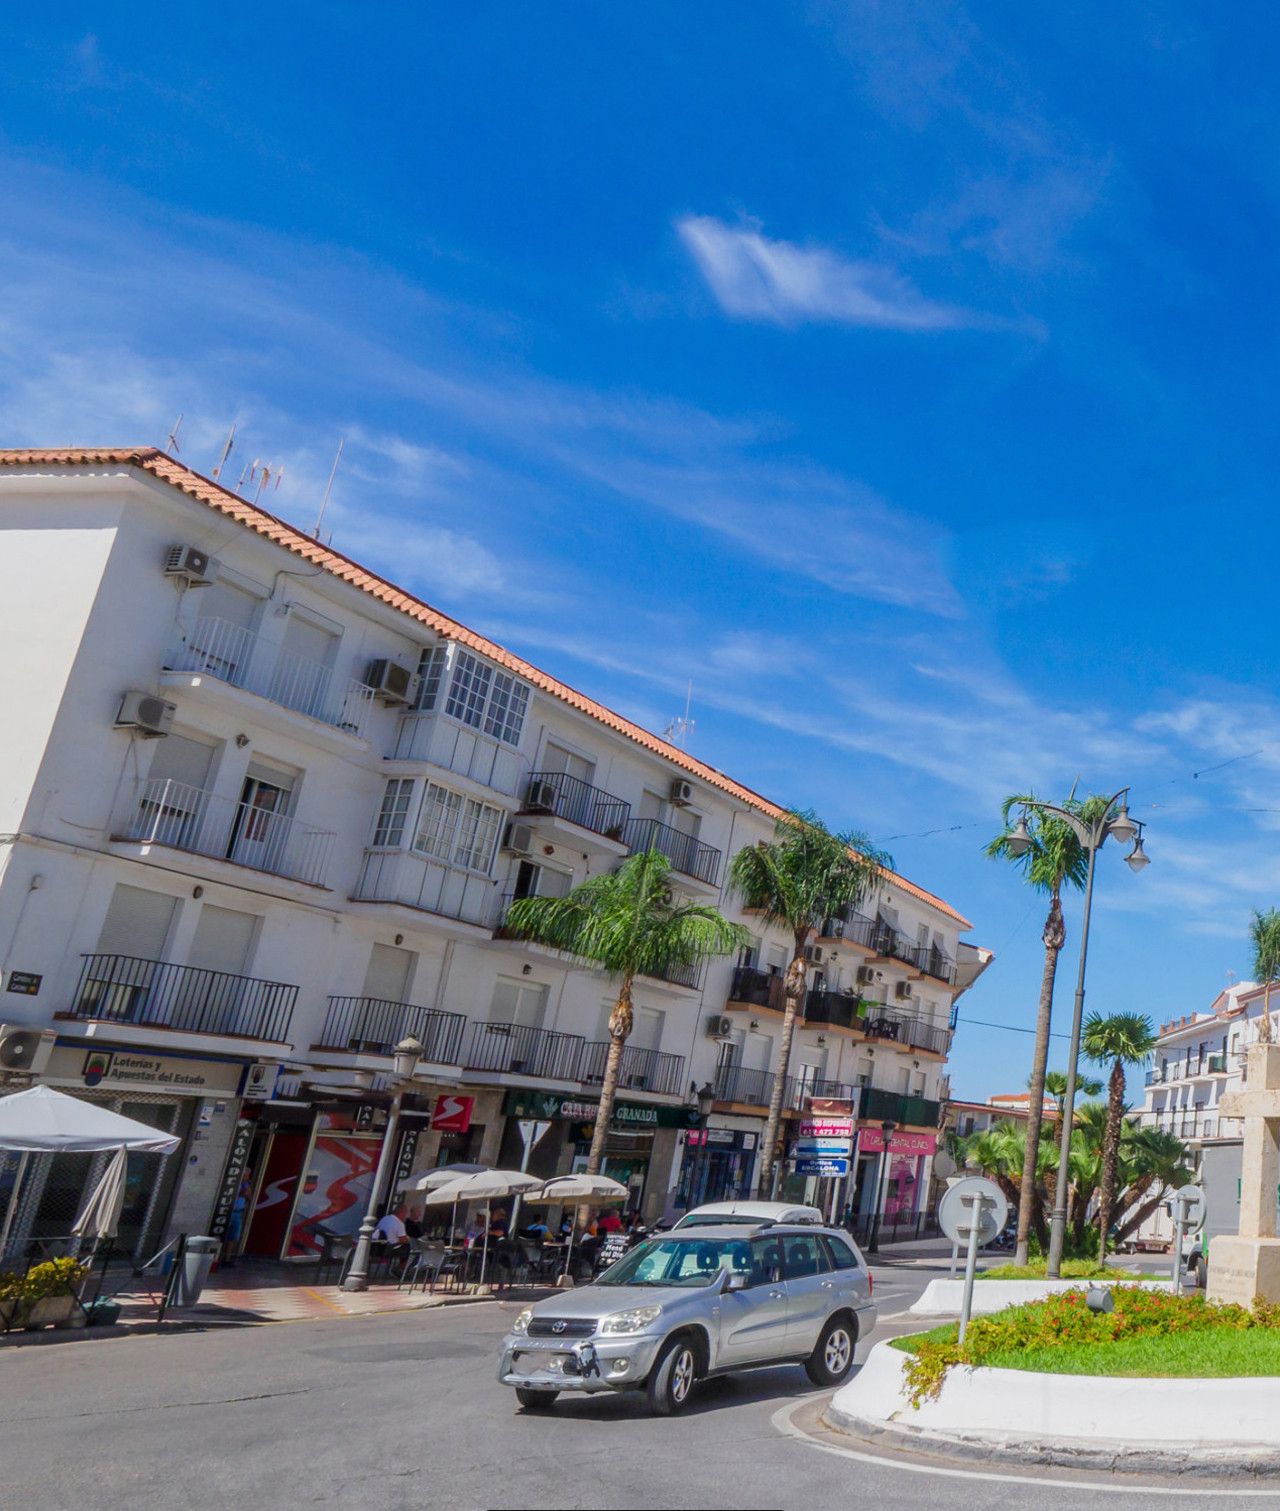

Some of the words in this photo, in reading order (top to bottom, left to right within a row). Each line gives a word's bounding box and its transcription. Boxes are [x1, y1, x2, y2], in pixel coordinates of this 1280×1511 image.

[111, 1068, 156, 1082] Apuestas
[158, 1072, 172, 1082] del
[173, 1073, 206, 1085] Estado
[616, 1106, 658, 1122] GRANADA
